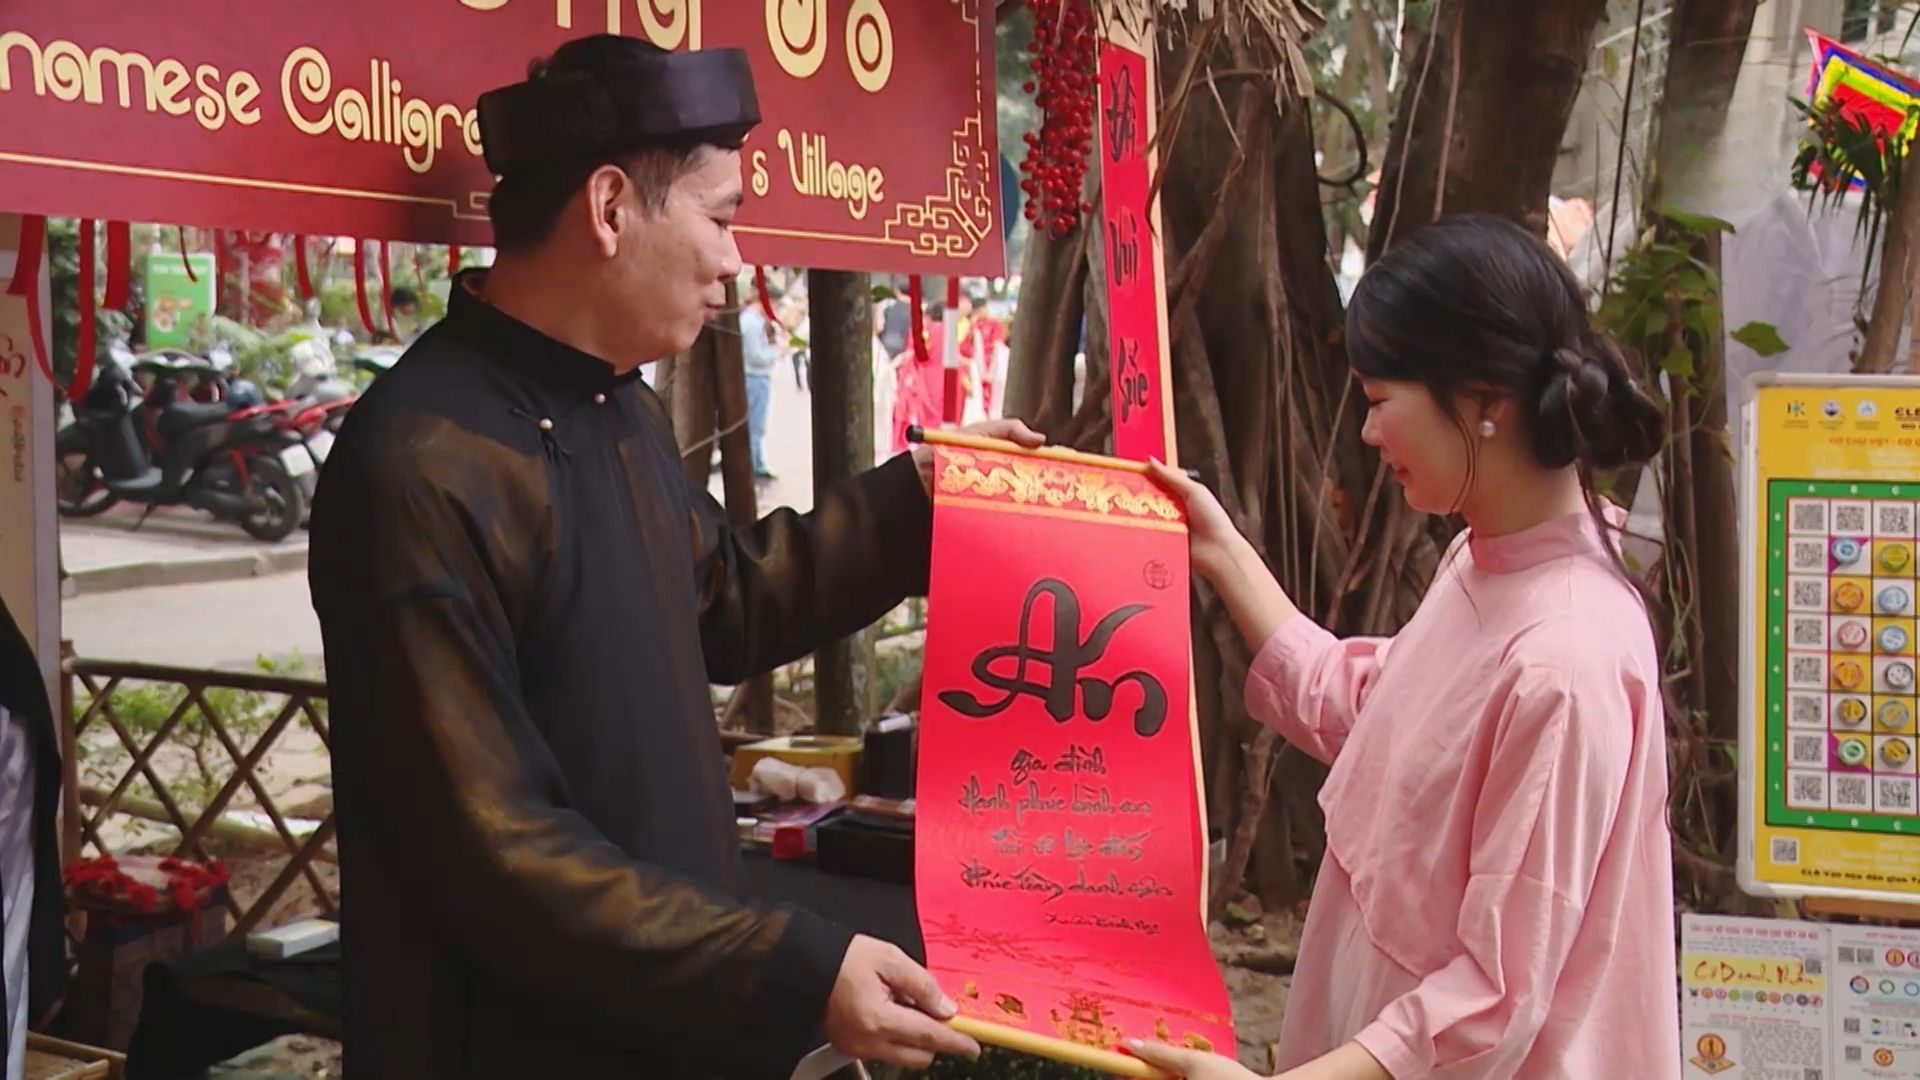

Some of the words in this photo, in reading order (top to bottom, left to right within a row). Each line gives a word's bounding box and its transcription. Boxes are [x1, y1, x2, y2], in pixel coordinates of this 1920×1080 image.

[281, 47, 487, 173] Calligra
[777, 127, 885, 220] Village
[1014, 780, 1066, 824] phúc
